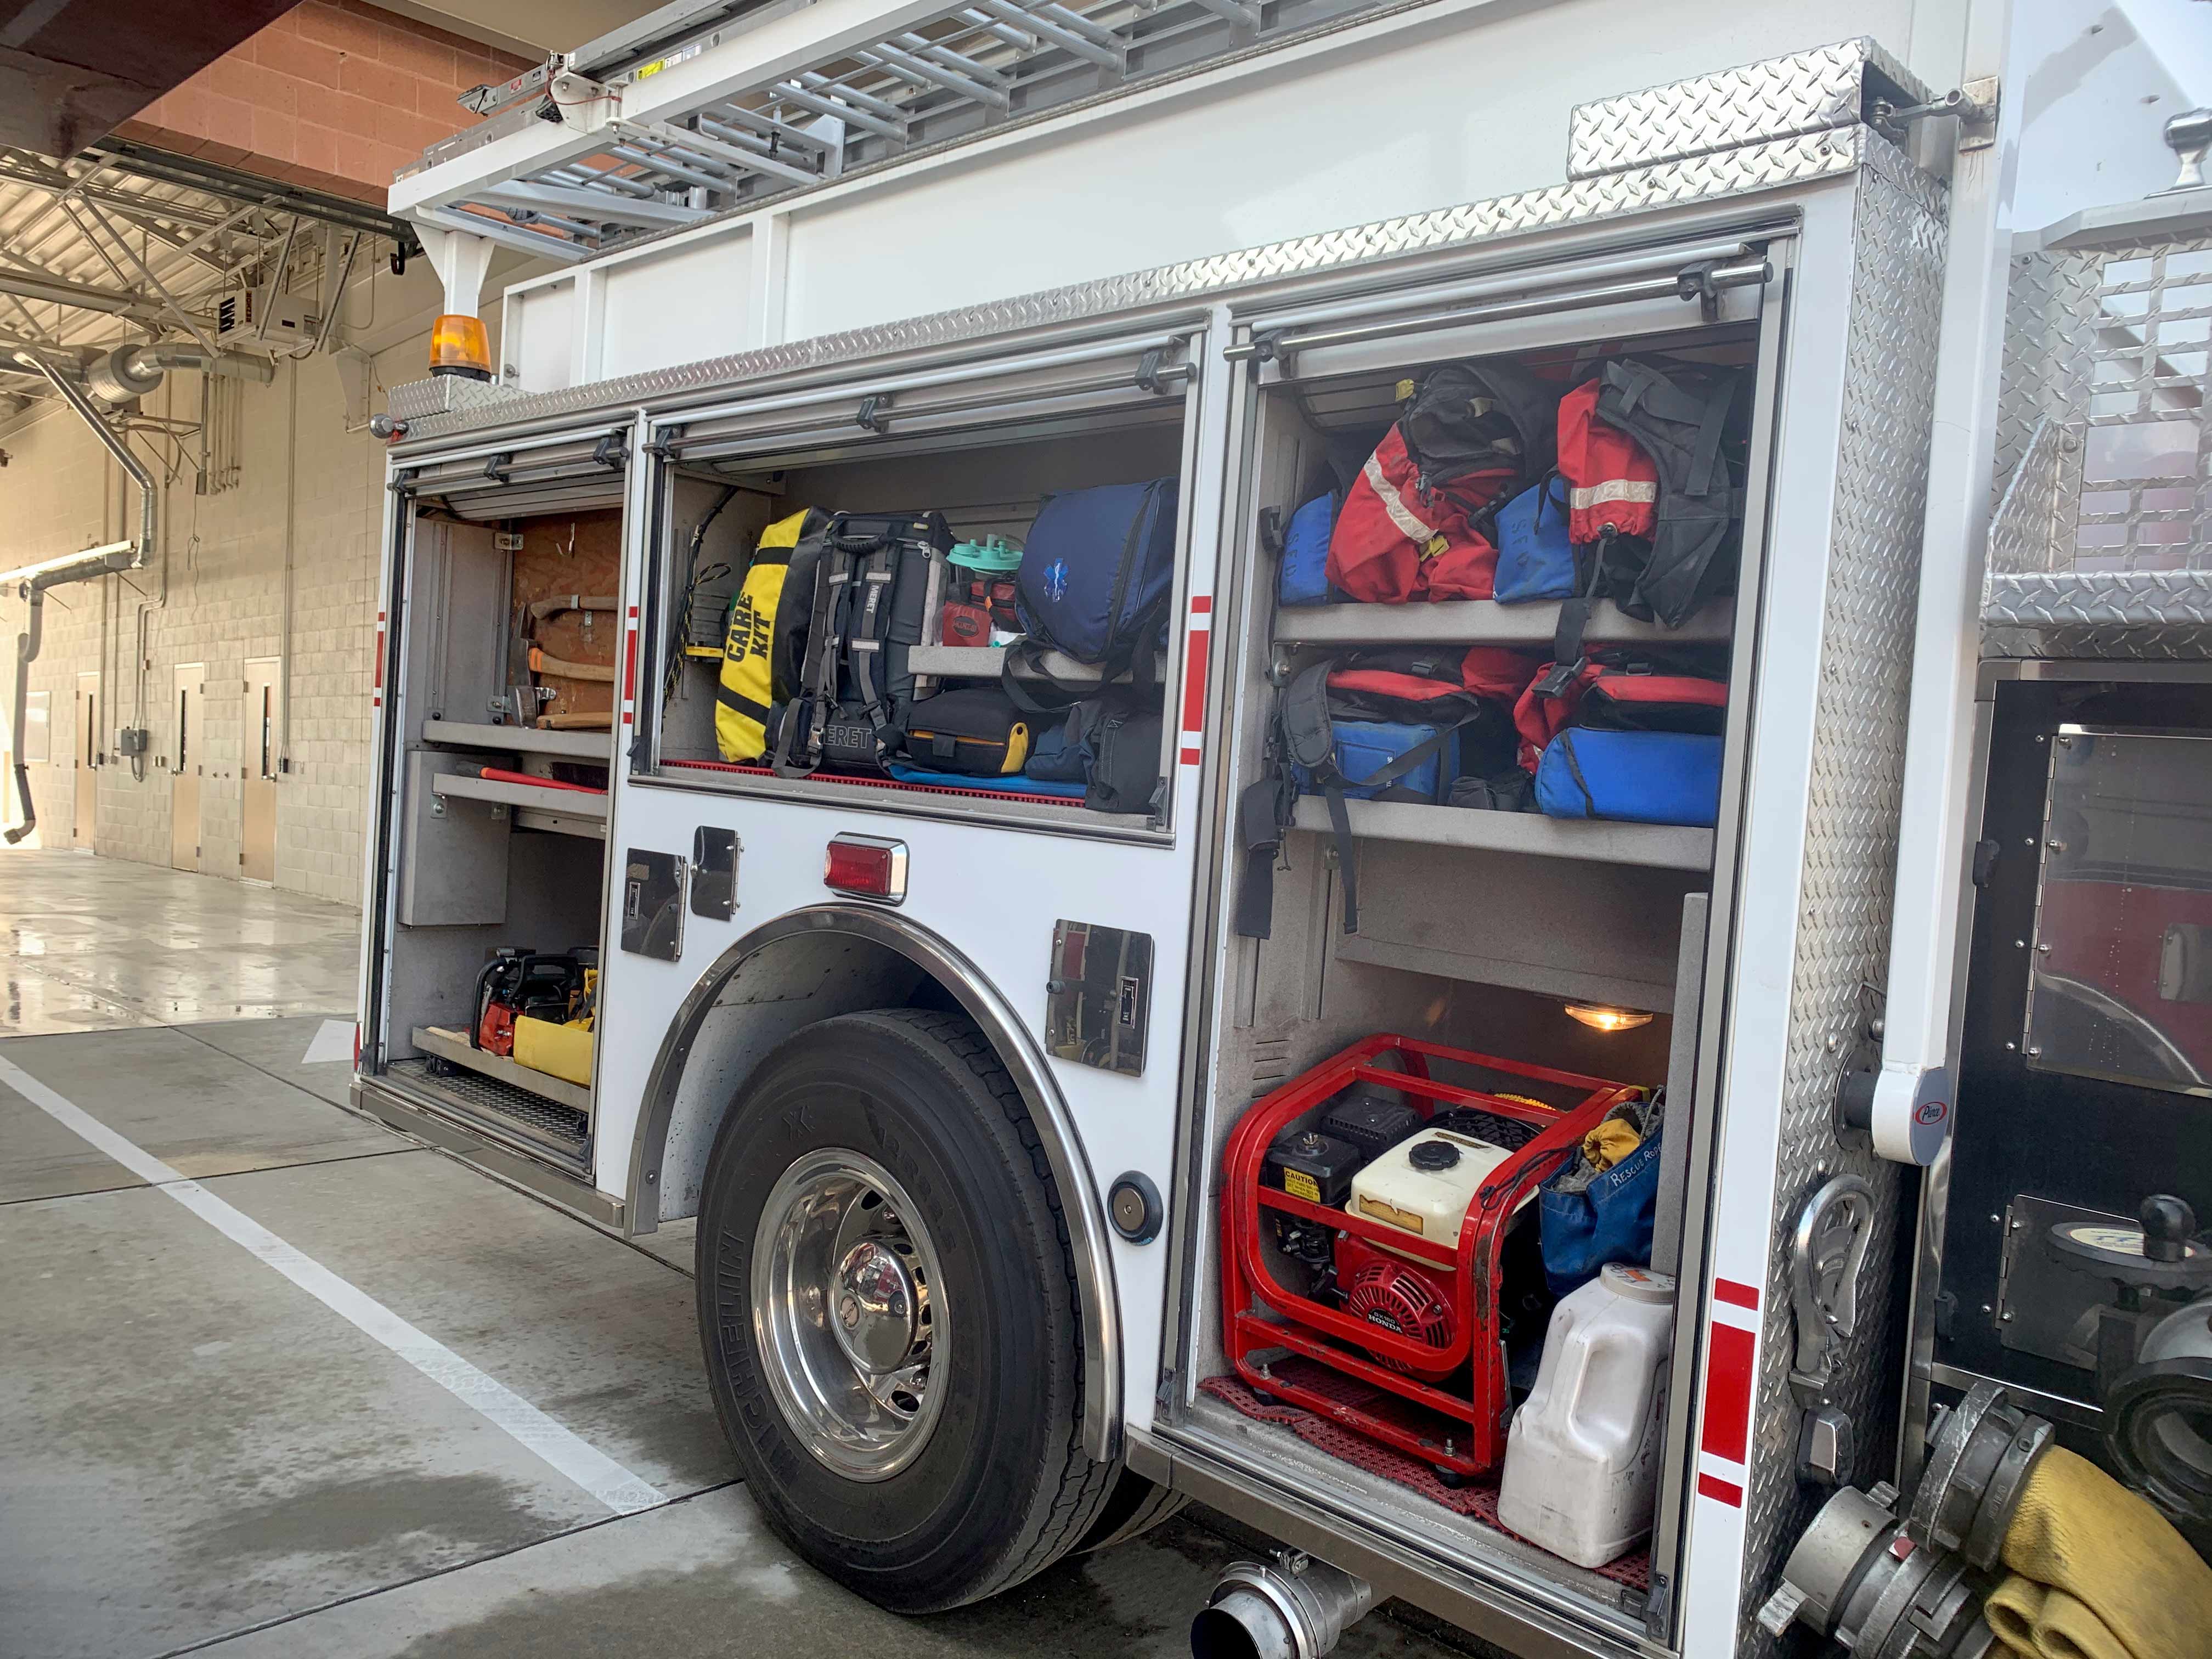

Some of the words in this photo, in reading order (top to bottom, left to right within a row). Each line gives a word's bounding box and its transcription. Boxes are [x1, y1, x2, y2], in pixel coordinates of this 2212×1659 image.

[866, 585, 879, 613] MERET
[727, 591, 753, 662] CARE
[749, 610, 771, 661] KIT
[824, 724, 872, 749] ERET
[1922, 1105, 1940, 1121] Pierce
[1610, 1158, 1644, 1187] RESCUE
[1644, 1143, 1662, 1161] ROPE
[1368, 1313, 1403, 1334] HONDA
[719, 1231, 802, 1487] MICHELIN
